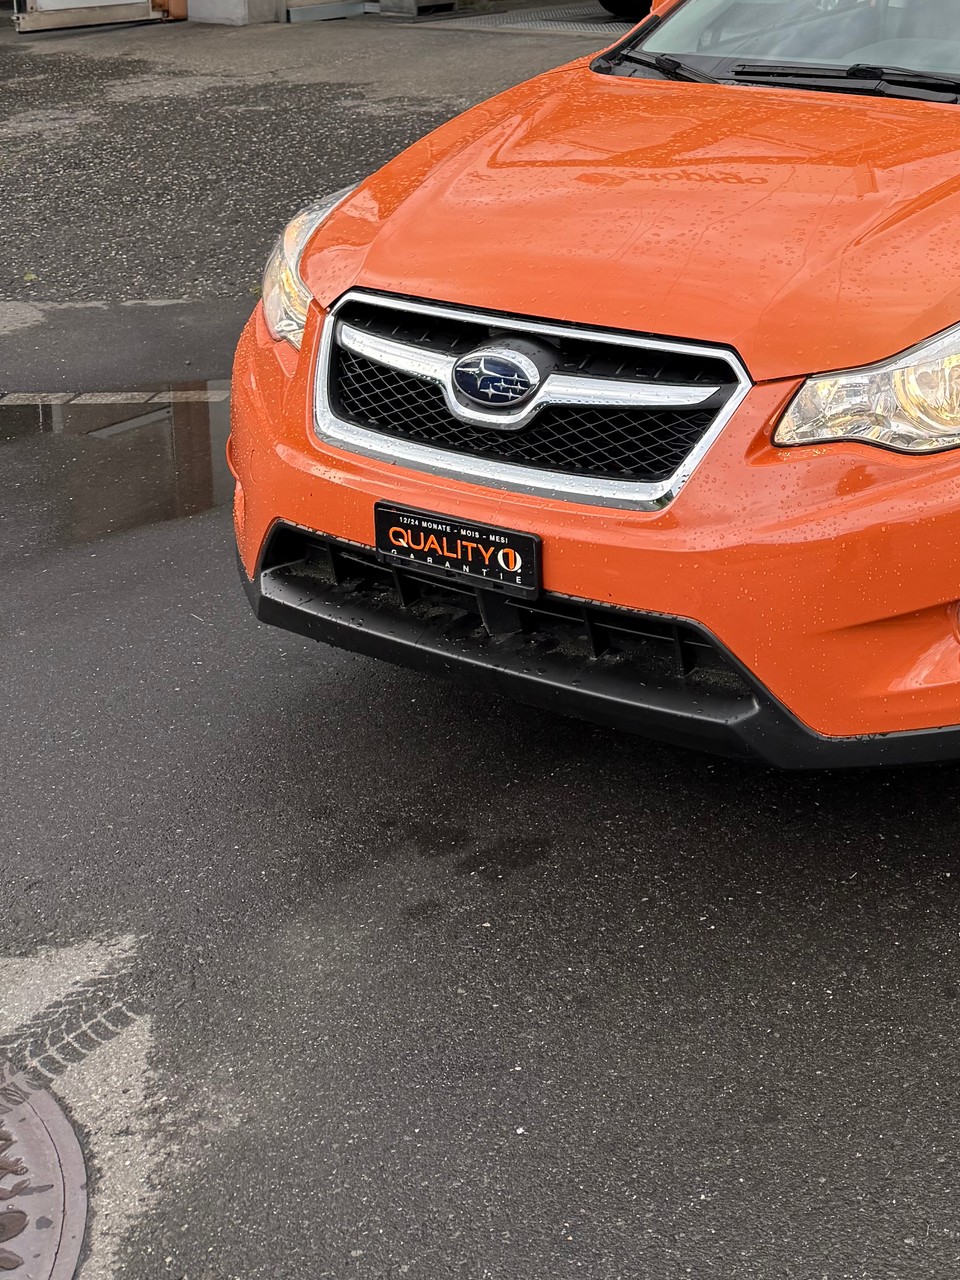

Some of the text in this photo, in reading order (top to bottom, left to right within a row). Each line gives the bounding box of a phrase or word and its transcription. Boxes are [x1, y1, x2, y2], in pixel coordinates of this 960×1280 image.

[388, 526, 495, 565] QUALITY
[399, 516, 419, 526] 12/24
[421, 520, 451, 533] MONATE
[460, 528, 480, 539] MOIS
[489, 534, 508, 544] MESI
